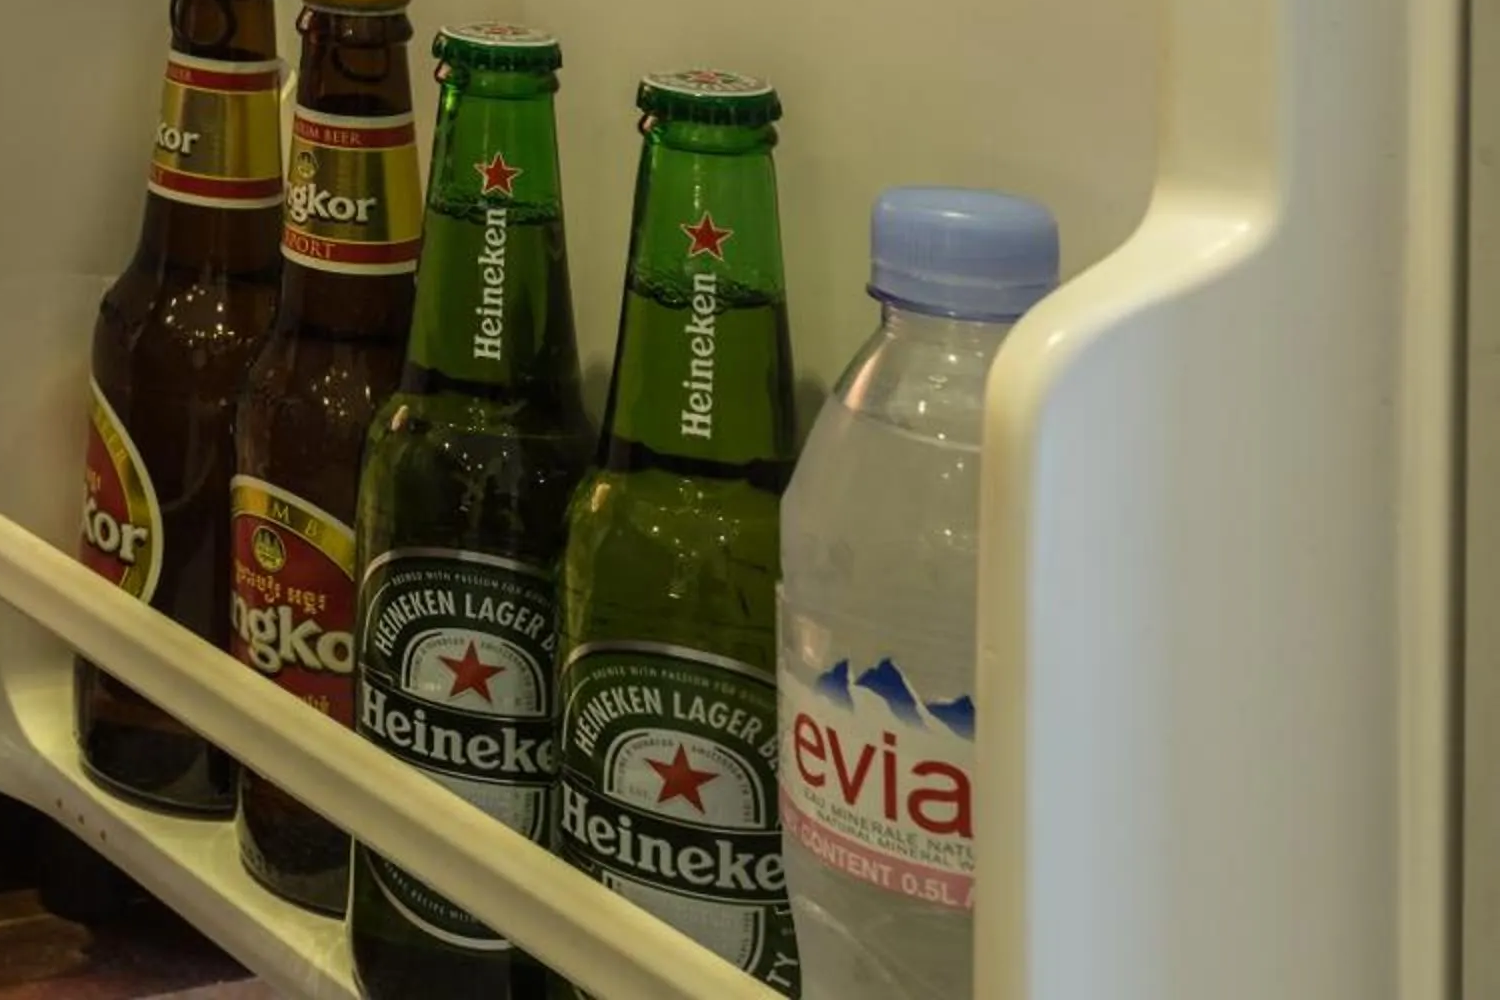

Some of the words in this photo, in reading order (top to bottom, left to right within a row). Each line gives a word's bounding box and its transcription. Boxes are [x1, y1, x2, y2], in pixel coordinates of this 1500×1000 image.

[323, 129, 363, 146] BEER
[285, 231, 336, 260] PORT
[473, 207, 507, 361] Heineken
[680, 272, 717, 440] Heineken
[374, 588, 457, 658] HEINEKEN
[464, 592, 546, 641] LAGER
[661, 669, 710, 688] PASSION
[573, 685, 665, 758] HEINEKEN
[672, 690, 764, 745] LAGER
[793, 712, 974, 841] evia
[561, 781, 786, 892] Heineke
[816, 810, 870, 844] NATURAL
[876, 837, 951, 867] MINERAL
[830, 802, 918, 843] MINERALE
[800, 823, 894, 887] CONTENT
[901, 872, 959, 906] 0.5L
